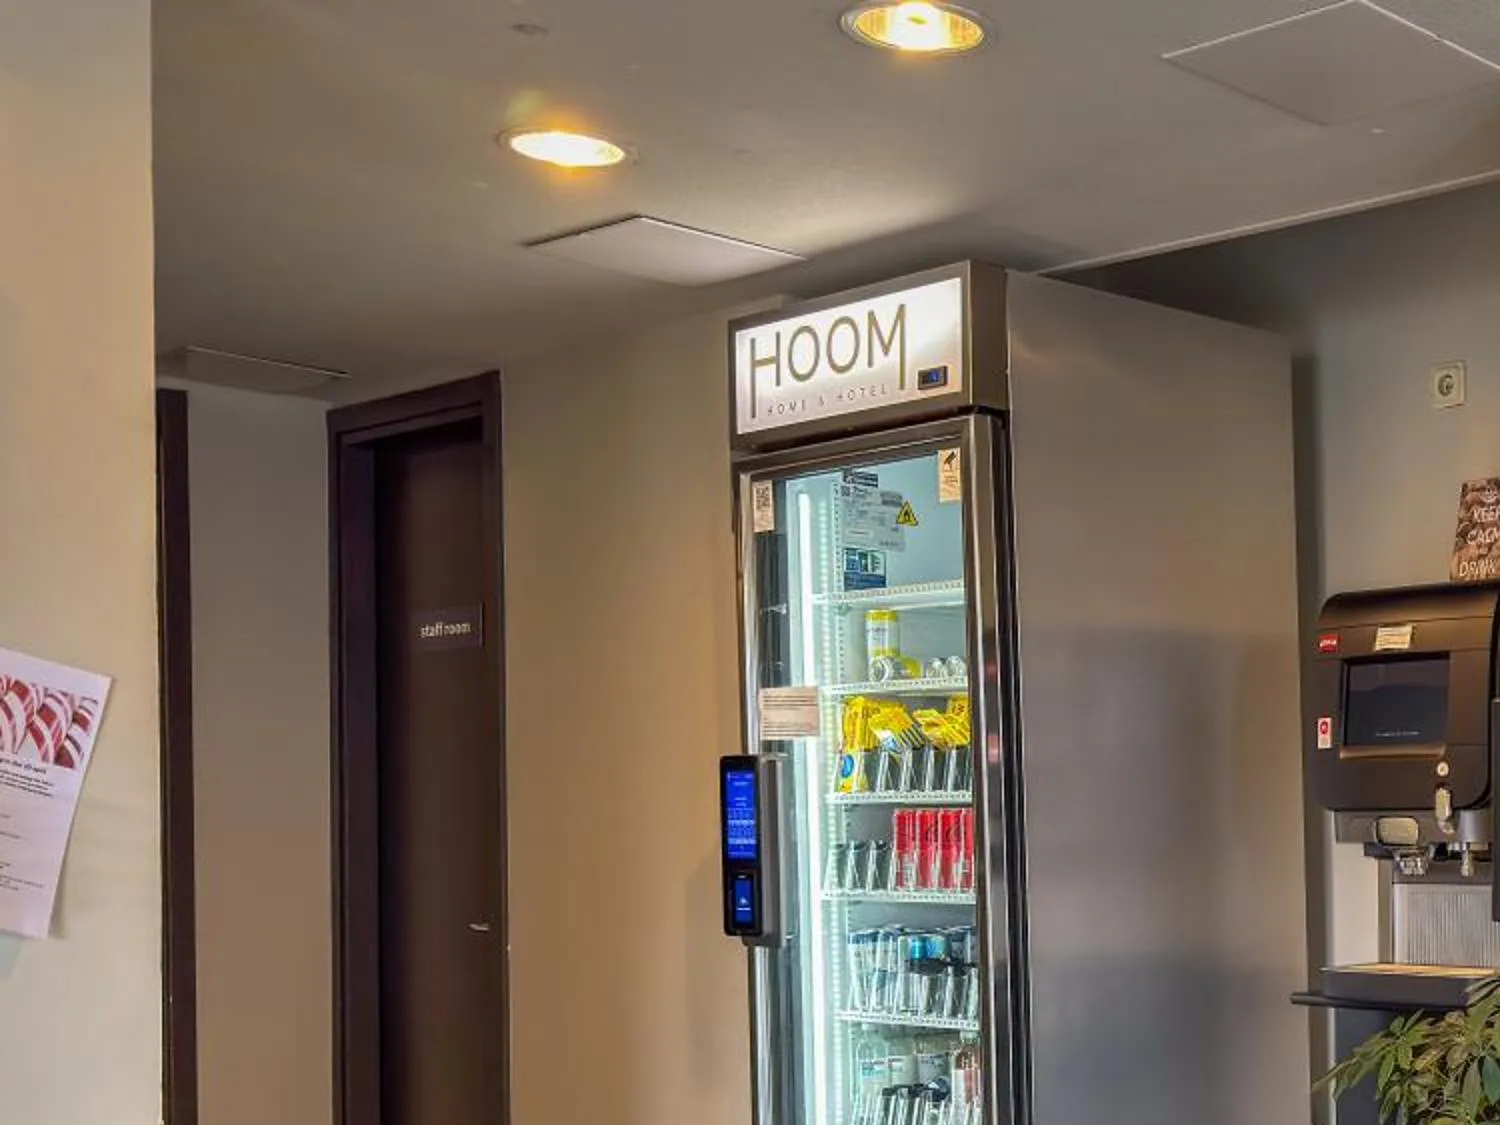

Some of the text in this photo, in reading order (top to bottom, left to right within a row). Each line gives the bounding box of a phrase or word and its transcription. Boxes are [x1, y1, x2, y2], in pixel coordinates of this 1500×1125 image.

[749, 303, 906, 419] HOOM
[836, 383, 888, 402] HOTEL
[1459, 558, 1496, 577] DRINK
[421, 620, 471, 638] staff room
